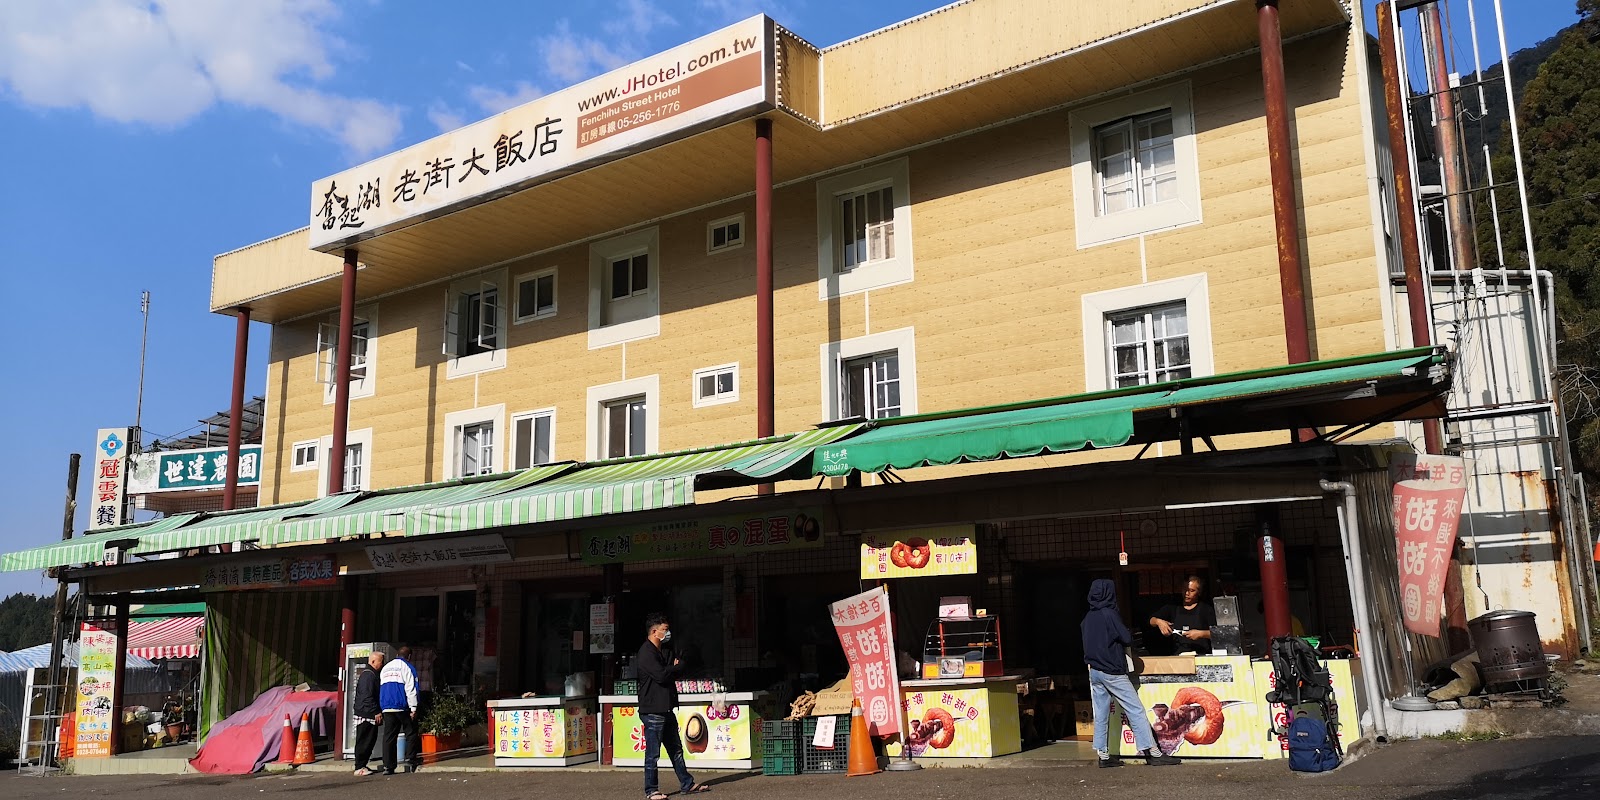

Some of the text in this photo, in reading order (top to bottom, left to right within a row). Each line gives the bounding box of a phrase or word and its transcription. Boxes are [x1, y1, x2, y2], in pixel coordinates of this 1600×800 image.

[578, 36, 757, 112] www.JHotel.com.tw
[580, 100, 681, 144] 訂房專線 05-256-1776
[581, 85, 681, 128] Fenchihu Street Hotel
[315, 117, 563, 230] 奮起湖 老街大飯店
[163, 453, 257, 483] 世達農園
[708, 516, 791, 550] 真の混蛋
[243, 563, 281, 583] 農特產品
[289, 559, 333, 581] 各式水果
[941, 692, 979, 721] 甜甜圈
